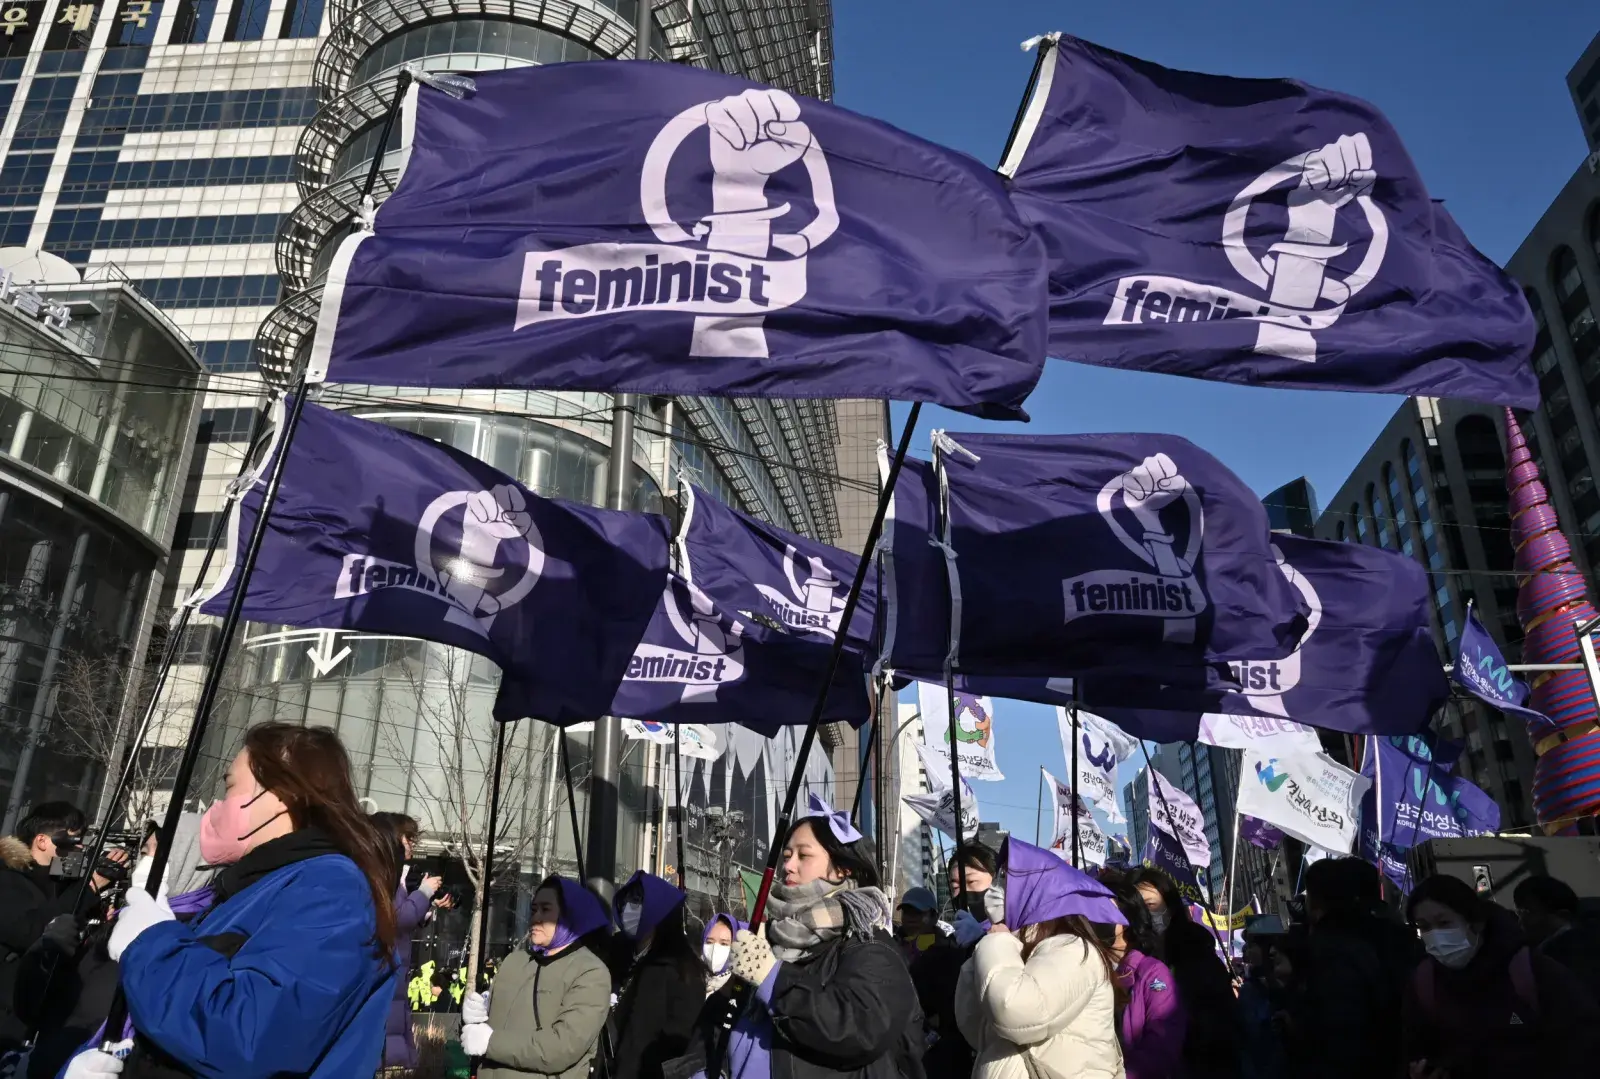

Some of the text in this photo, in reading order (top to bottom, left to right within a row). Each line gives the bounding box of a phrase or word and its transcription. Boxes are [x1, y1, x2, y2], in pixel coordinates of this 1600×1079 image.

[0, 1, 152, 36] 우체국
[535, 254, 771, 315] feminist
[1070, 576, 1196, 612] feminist
[624, 653, 727, 681] eminist
